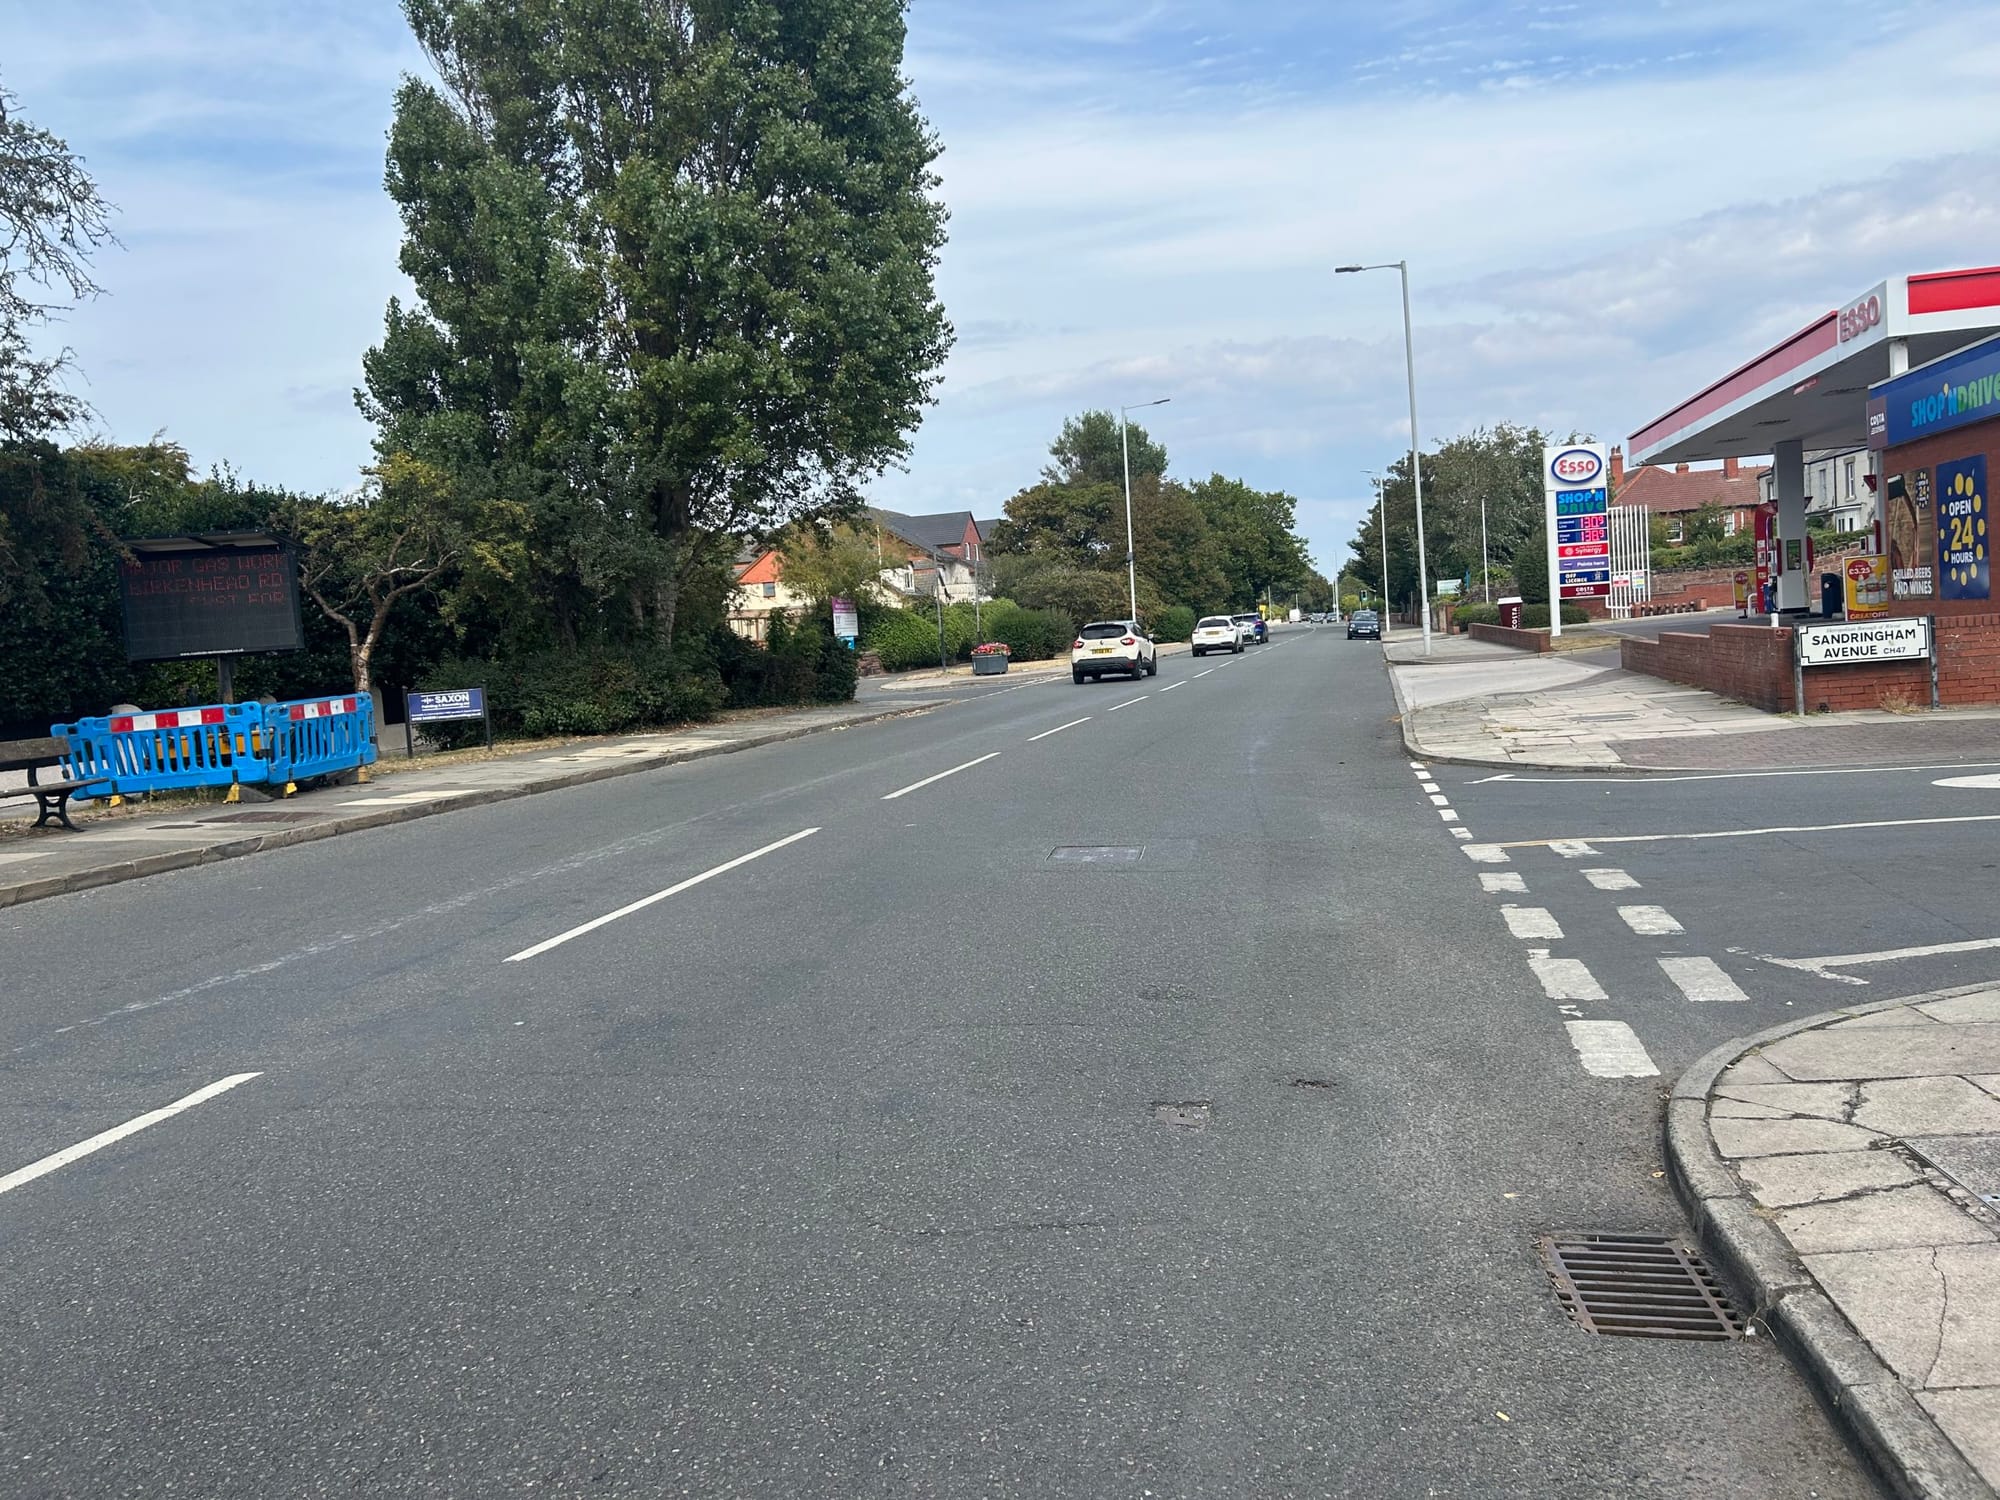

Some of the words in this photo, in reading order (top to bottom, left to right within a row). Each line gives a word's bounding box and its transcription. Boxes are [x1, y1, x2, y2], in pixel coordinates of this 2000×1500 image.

[1870, 413, 1885, 426] COSTA
[1558, 502, 1604, 514] DRIVE
[1949, 499, 1971, 516] OPEN
[1951, 516, 1974, 550] 24
[1951, 552, 1973, 564] HOURS
[1893, 569, 1913, 580] CHILLED
[1915, 567, 1931, 578] BEERS
[1893, 582, 1908, 595] AND
[1910, 580, 1932, 595] WINES
[1812, 629, 1916, 645] SANDRINGHAM
[1824, 645, 1878, 658] AVENUE
[1883, 647, 1906, 655] CH47
[435, 694, 469, 704] SAXON
